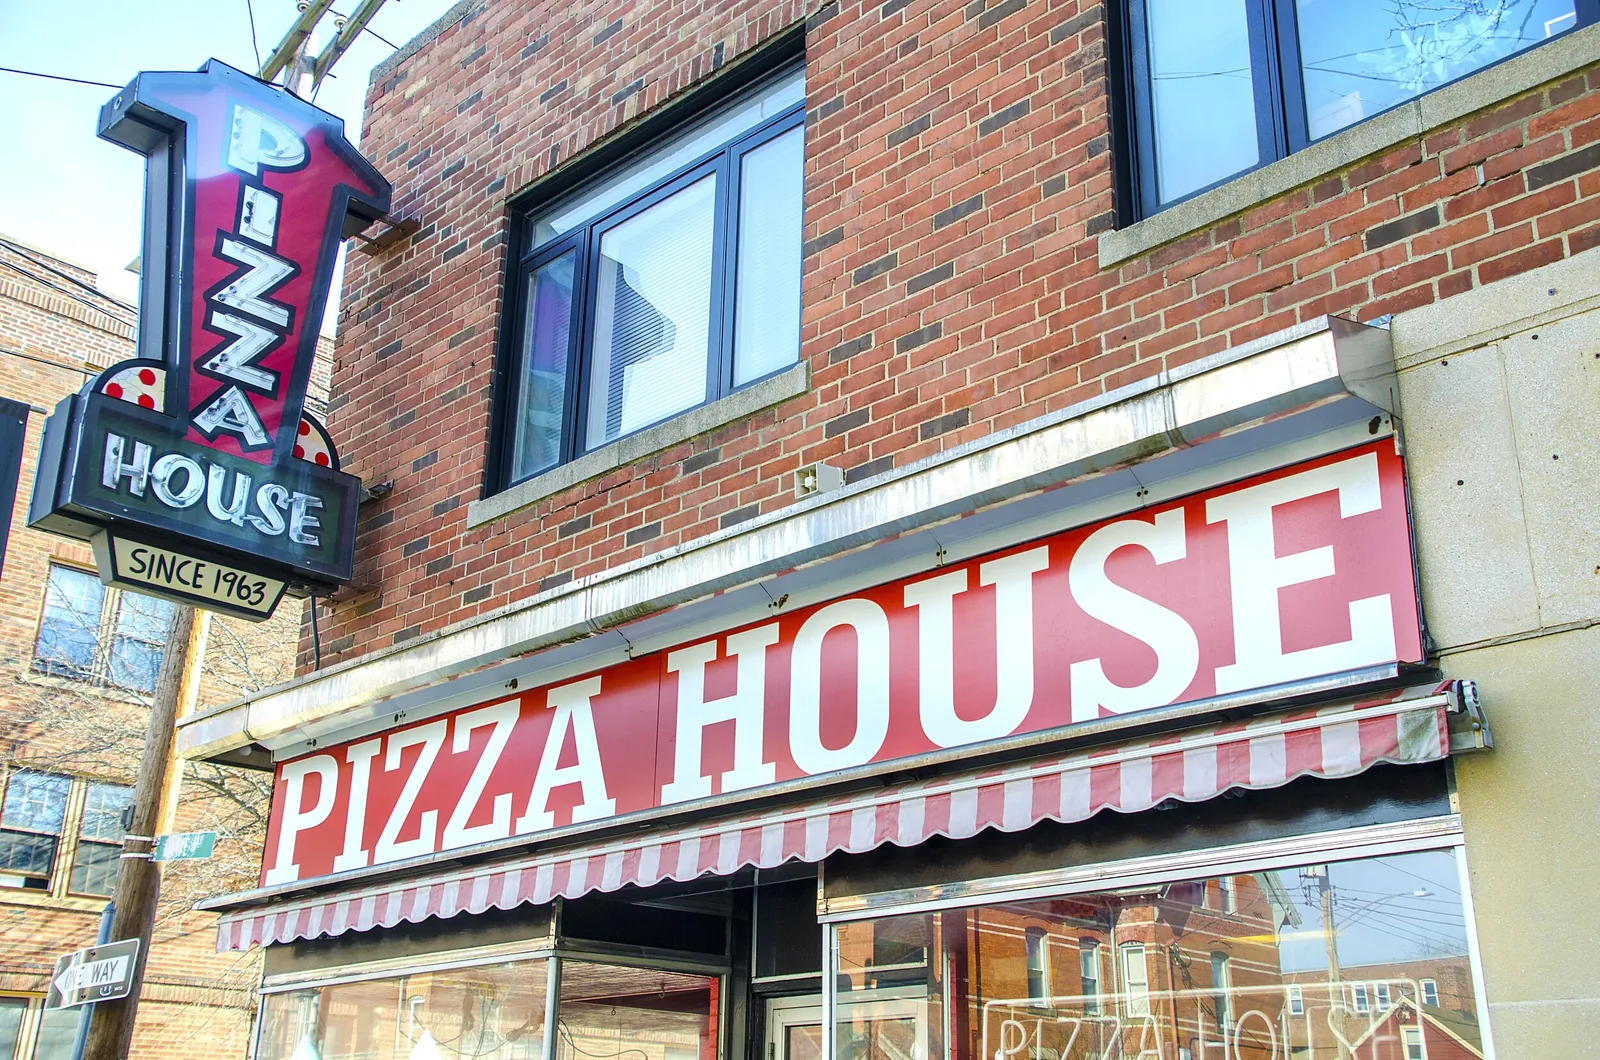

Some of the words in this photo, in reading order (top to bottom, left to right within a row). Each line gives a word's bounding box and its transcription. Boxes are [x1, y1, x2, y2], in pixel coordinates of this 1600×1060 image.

[193, 104, 305, 446] PIZZA
[102, 432, 323, 546] HOUSE
[129, 548, 206, 588] SINCE
[213, 569, 267, 605] 1963
[266, 675, 616, 887] PIZZA
[661, 452, 1397, 806] HOUSE
[90, 960, 119, 984] WAY
